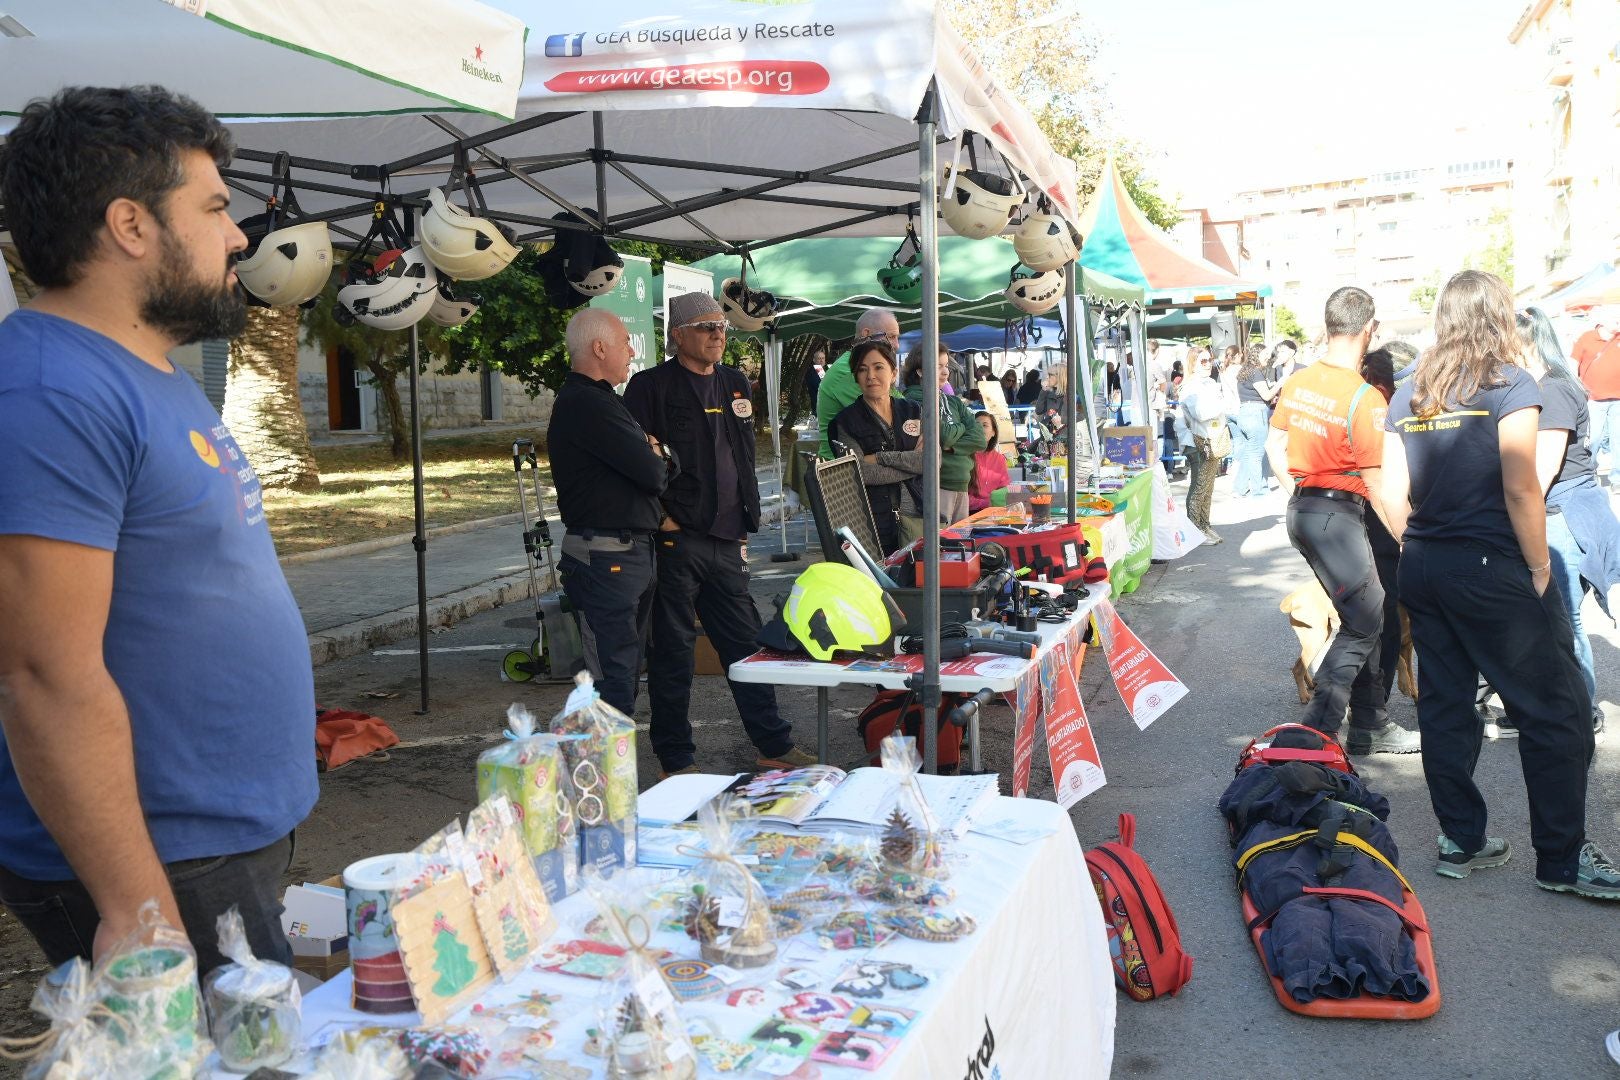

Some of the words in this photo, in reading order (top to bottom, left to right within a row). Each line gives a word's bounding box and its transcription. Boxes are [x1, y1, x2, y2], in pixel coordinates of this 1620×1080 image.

[738, 27, 748, 43] y
[755, 22, 835, 39] Rescate
[461, 57, 503, 84] Heineken
[578, 66, 793, 92] www.geaesp.org
